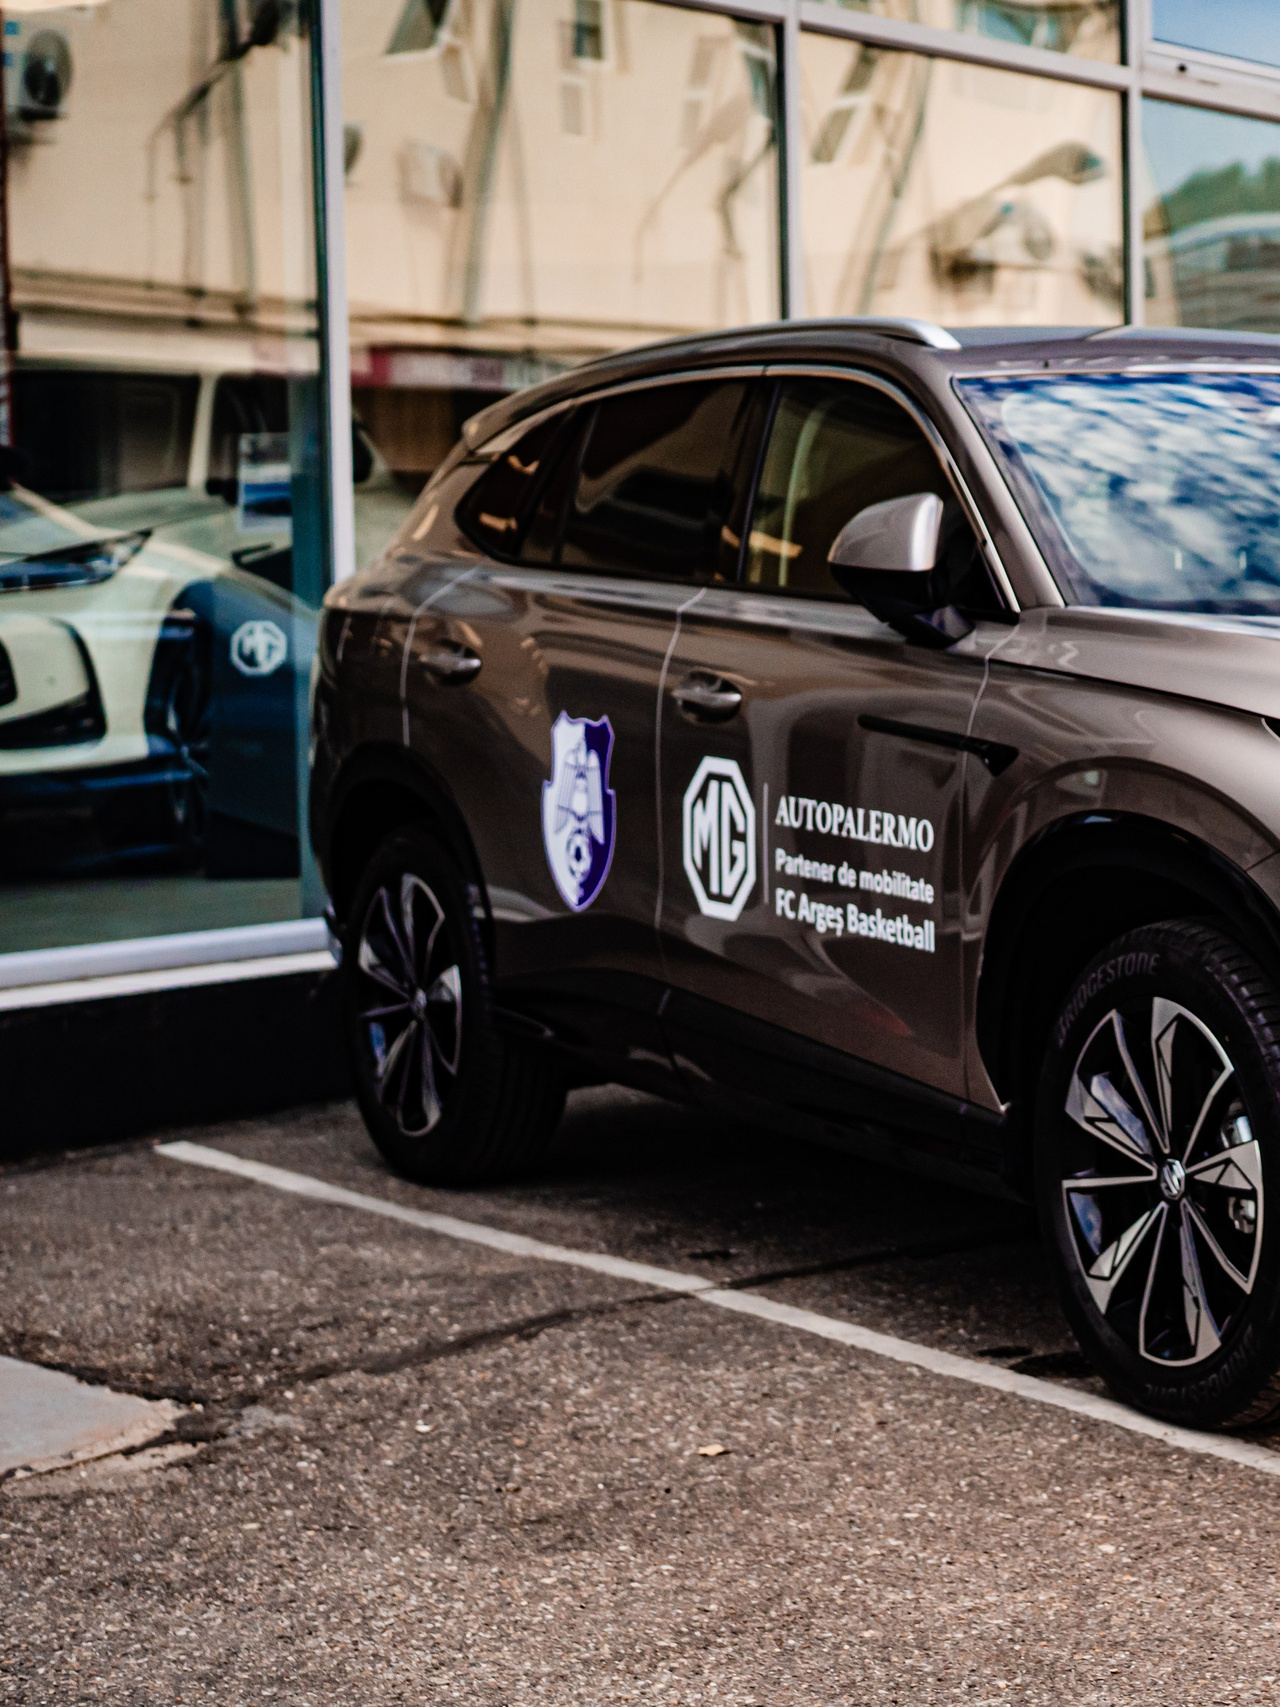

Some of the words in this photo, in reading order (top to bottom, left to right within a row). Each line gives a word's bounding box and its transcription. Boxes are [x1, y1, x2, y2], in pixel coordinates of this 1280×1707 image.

[692, 778, 747, 898] MG
[774, 794, 935, 853] AUTOPALERMO
[774, 847, 836, 880] Partener
[837, 861, 857, 888] de
[859, 869, 935, 905] mobilitate
[774, 886, 796, 920] FC
[846, 902, 936, 953] Basketball
